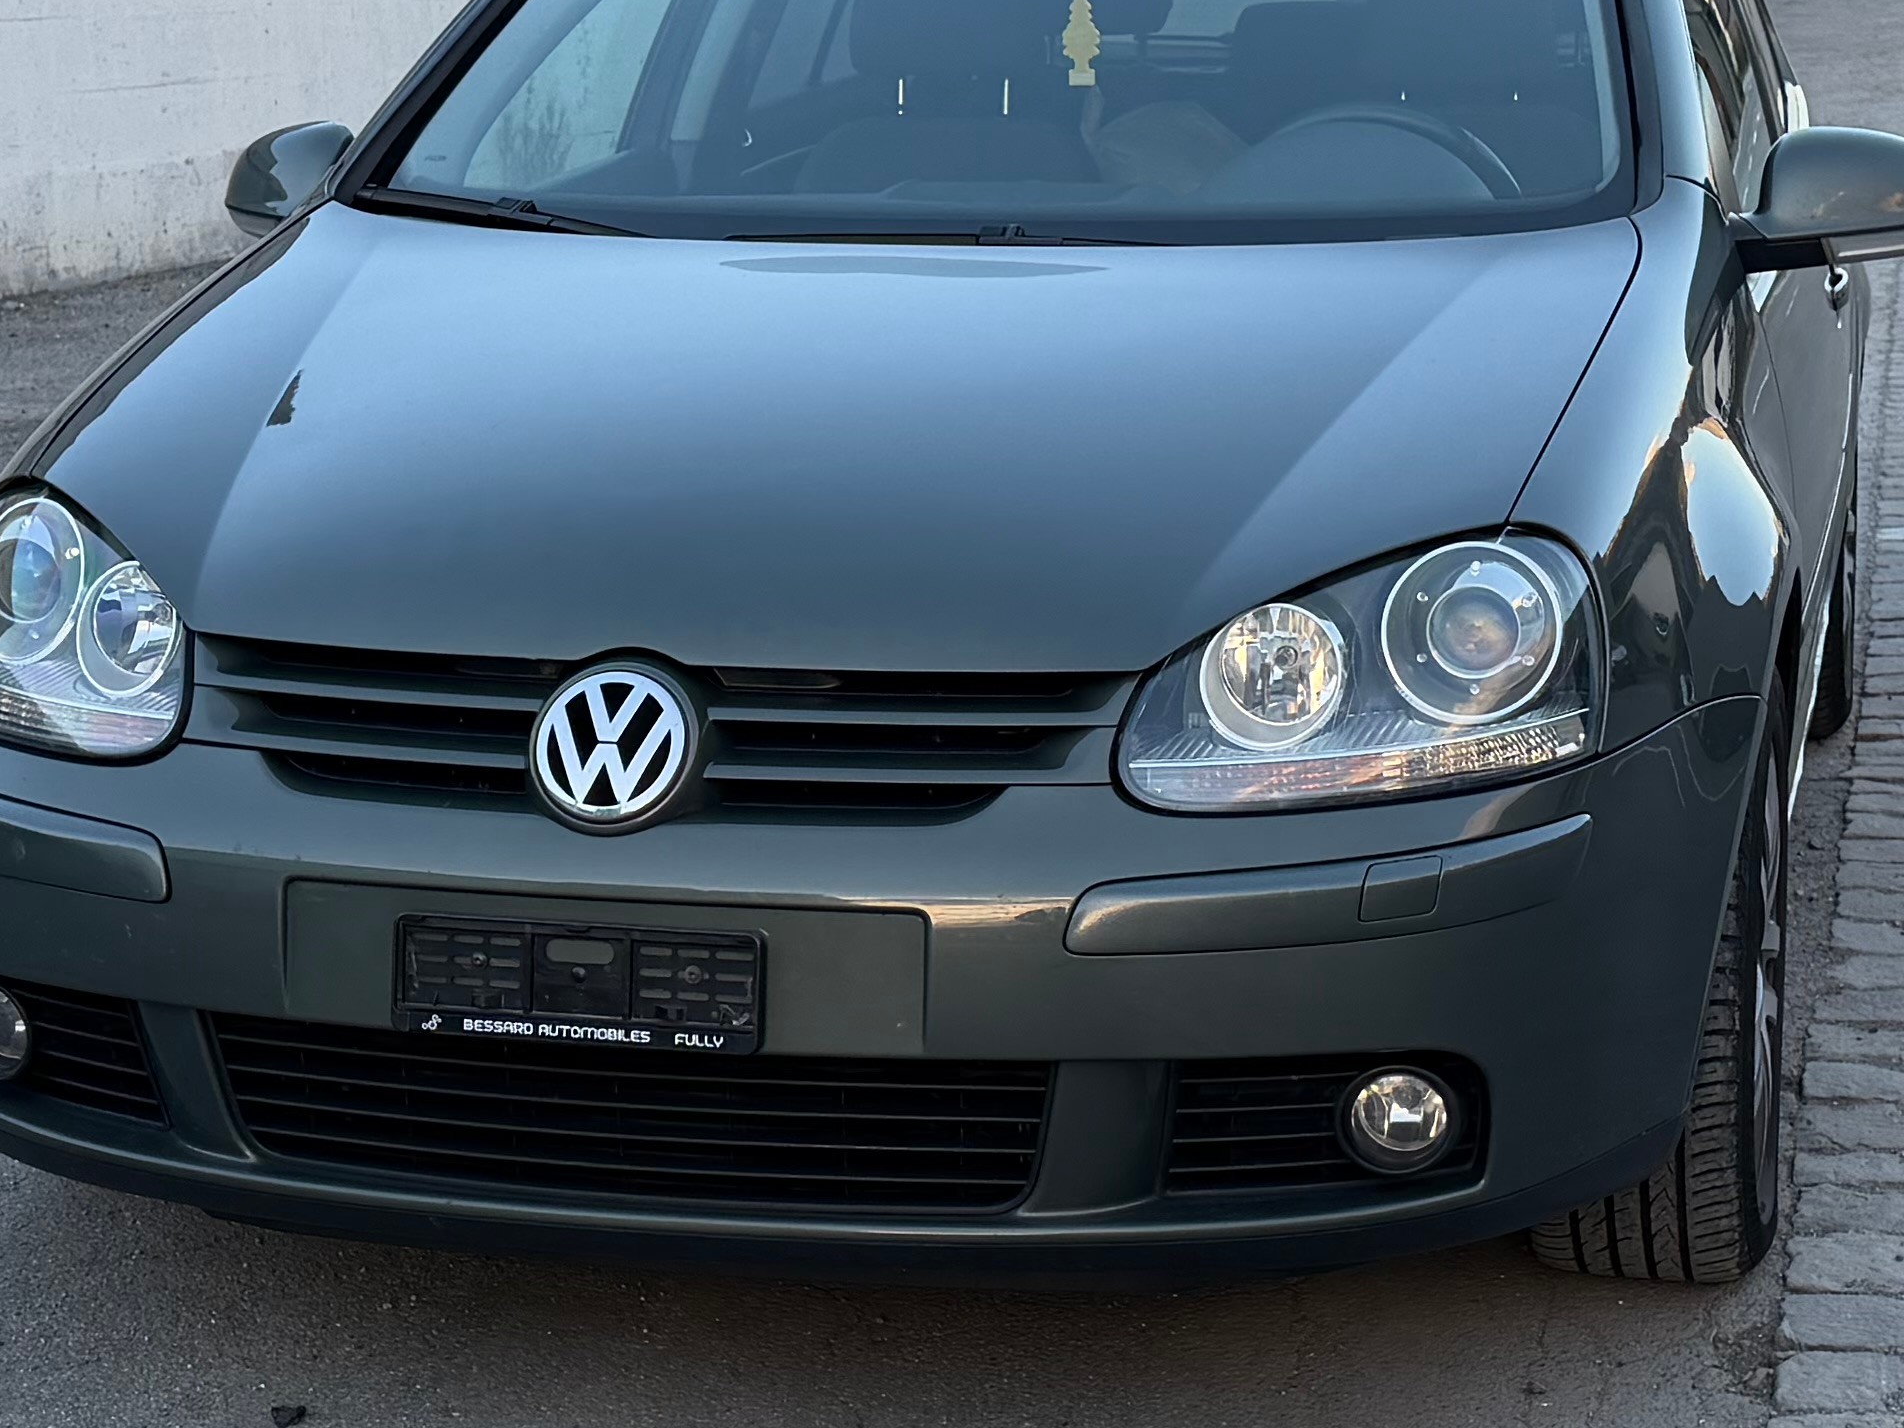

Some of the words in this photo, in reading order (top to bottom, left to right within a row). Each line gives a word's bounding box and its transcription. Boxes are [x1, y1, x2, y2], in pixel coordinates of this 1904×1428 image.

[463, 1018, 534, 1035] BESSARD
[538, 1024, 651, 1043] AUTOMOBILES
[674, 1033, 724, 1048] FULLY
